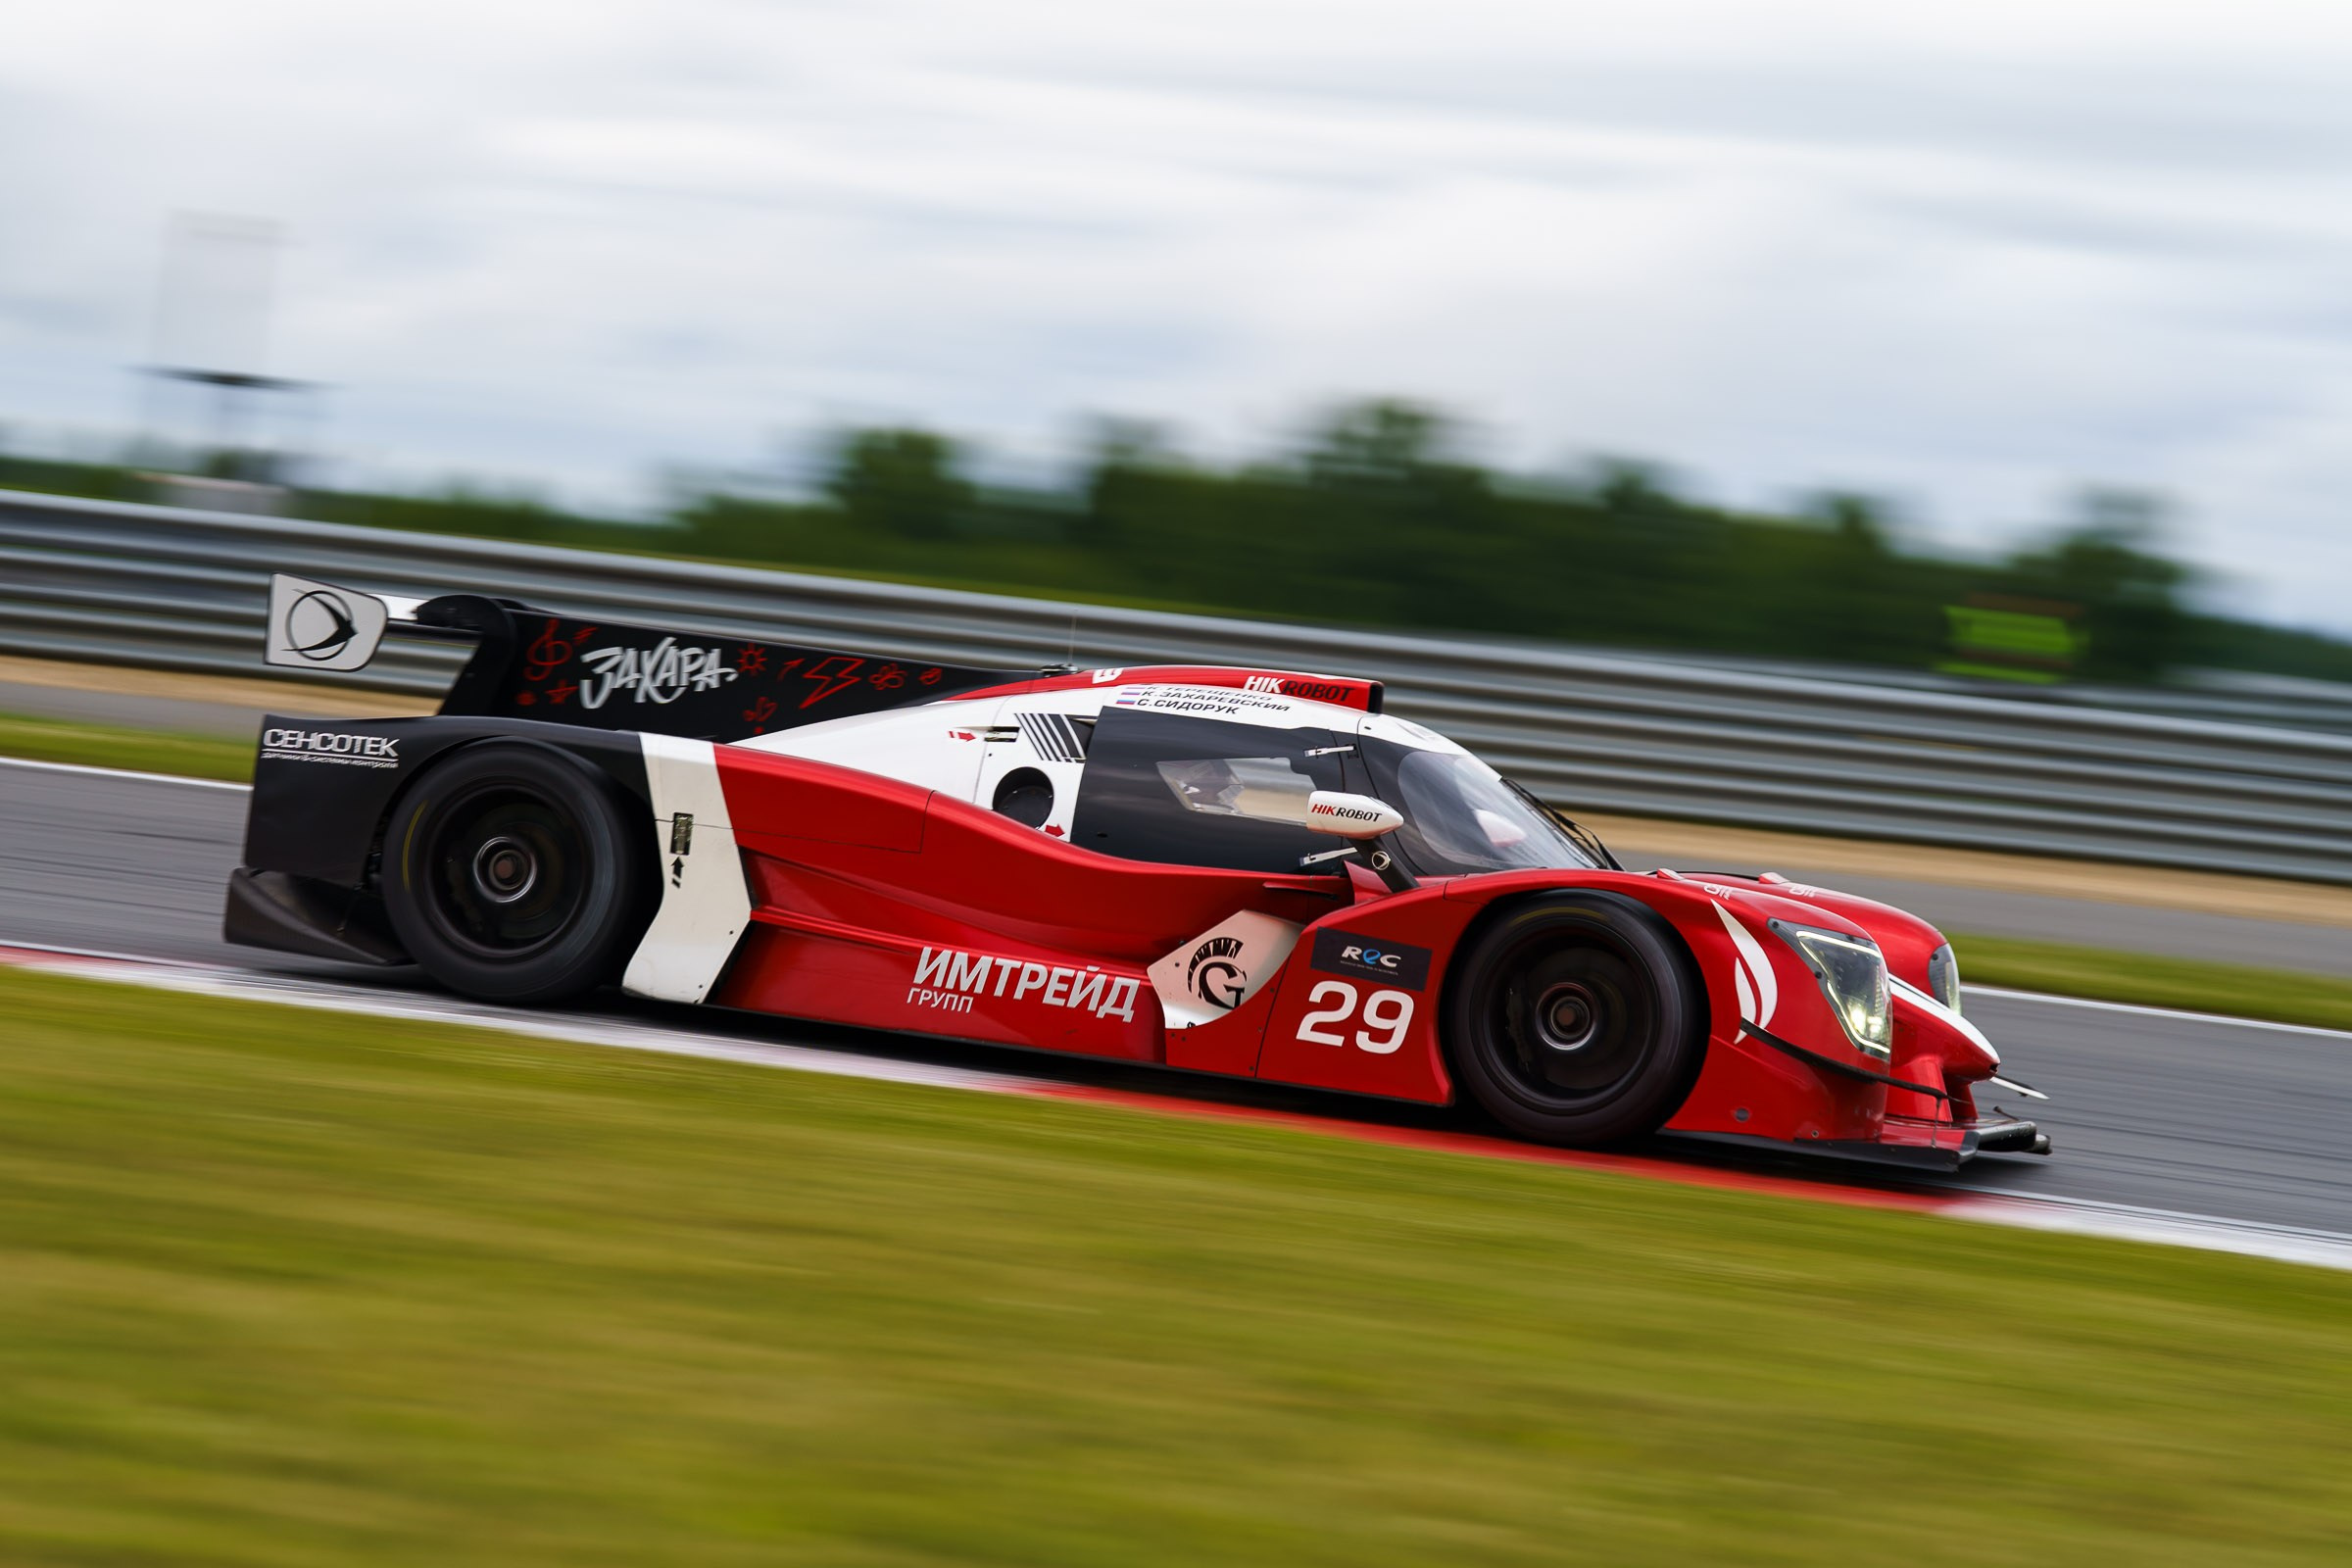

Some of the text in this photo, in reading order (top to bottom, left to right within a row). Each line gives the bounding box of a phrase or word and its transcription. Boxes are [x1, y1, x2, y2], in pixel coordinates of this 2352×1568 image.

[1243, 675, 1355, 702] HIKROBOT
[263, 728, 400, 757] СЕНСОТЕК
[1311, 804, 1382, 821] HIKROBOT
[913, 947, 1141, 1023] ИМТРЕЙД
[906, 987, 973, 1013] ГРУПП
[1296, 980, 1415, 1054] 29
